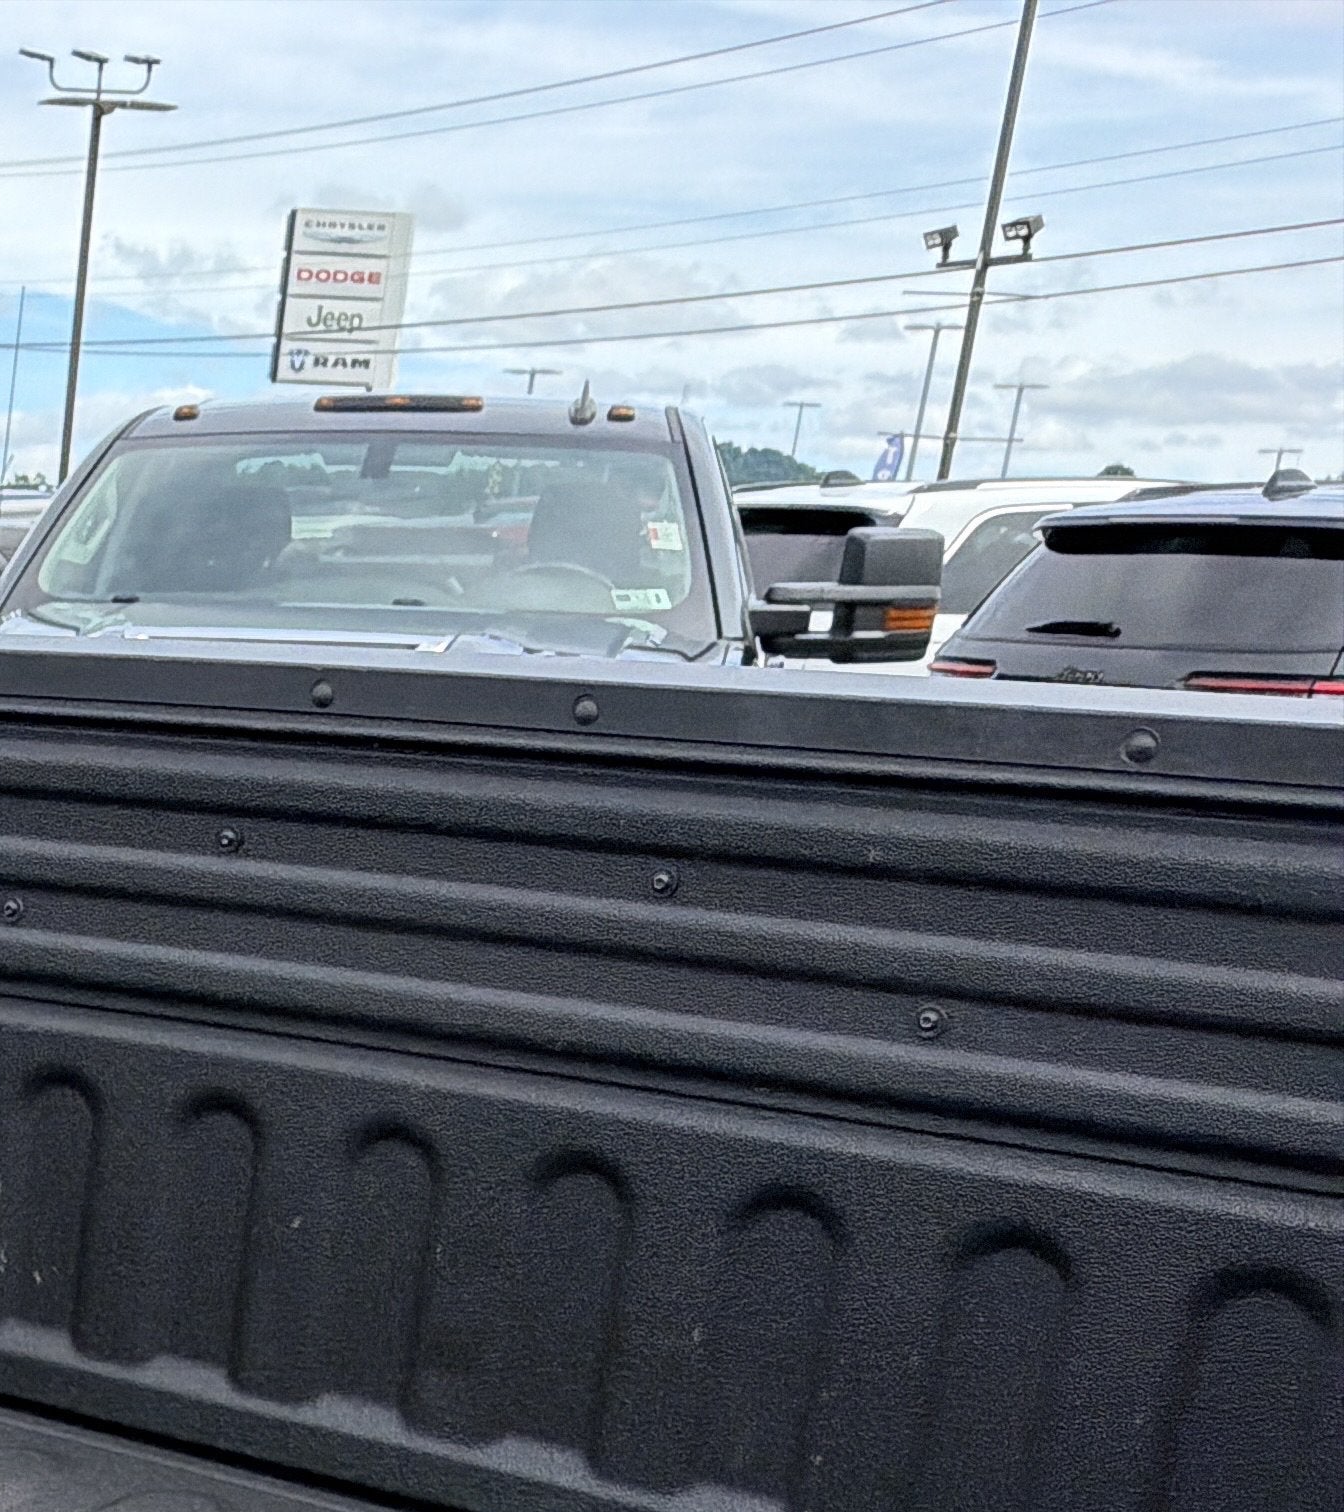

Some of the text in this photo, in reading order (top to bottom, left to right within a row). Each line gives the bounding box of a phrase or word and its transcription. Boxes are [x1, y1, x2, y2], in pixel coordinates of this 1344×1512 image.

[304, 219, 386, 231] CHRYSLER
[296, 268, 382, 285] DODGE
[306, 304, 364, 334] Jeep
[313, 357, 371, 370] RAM
